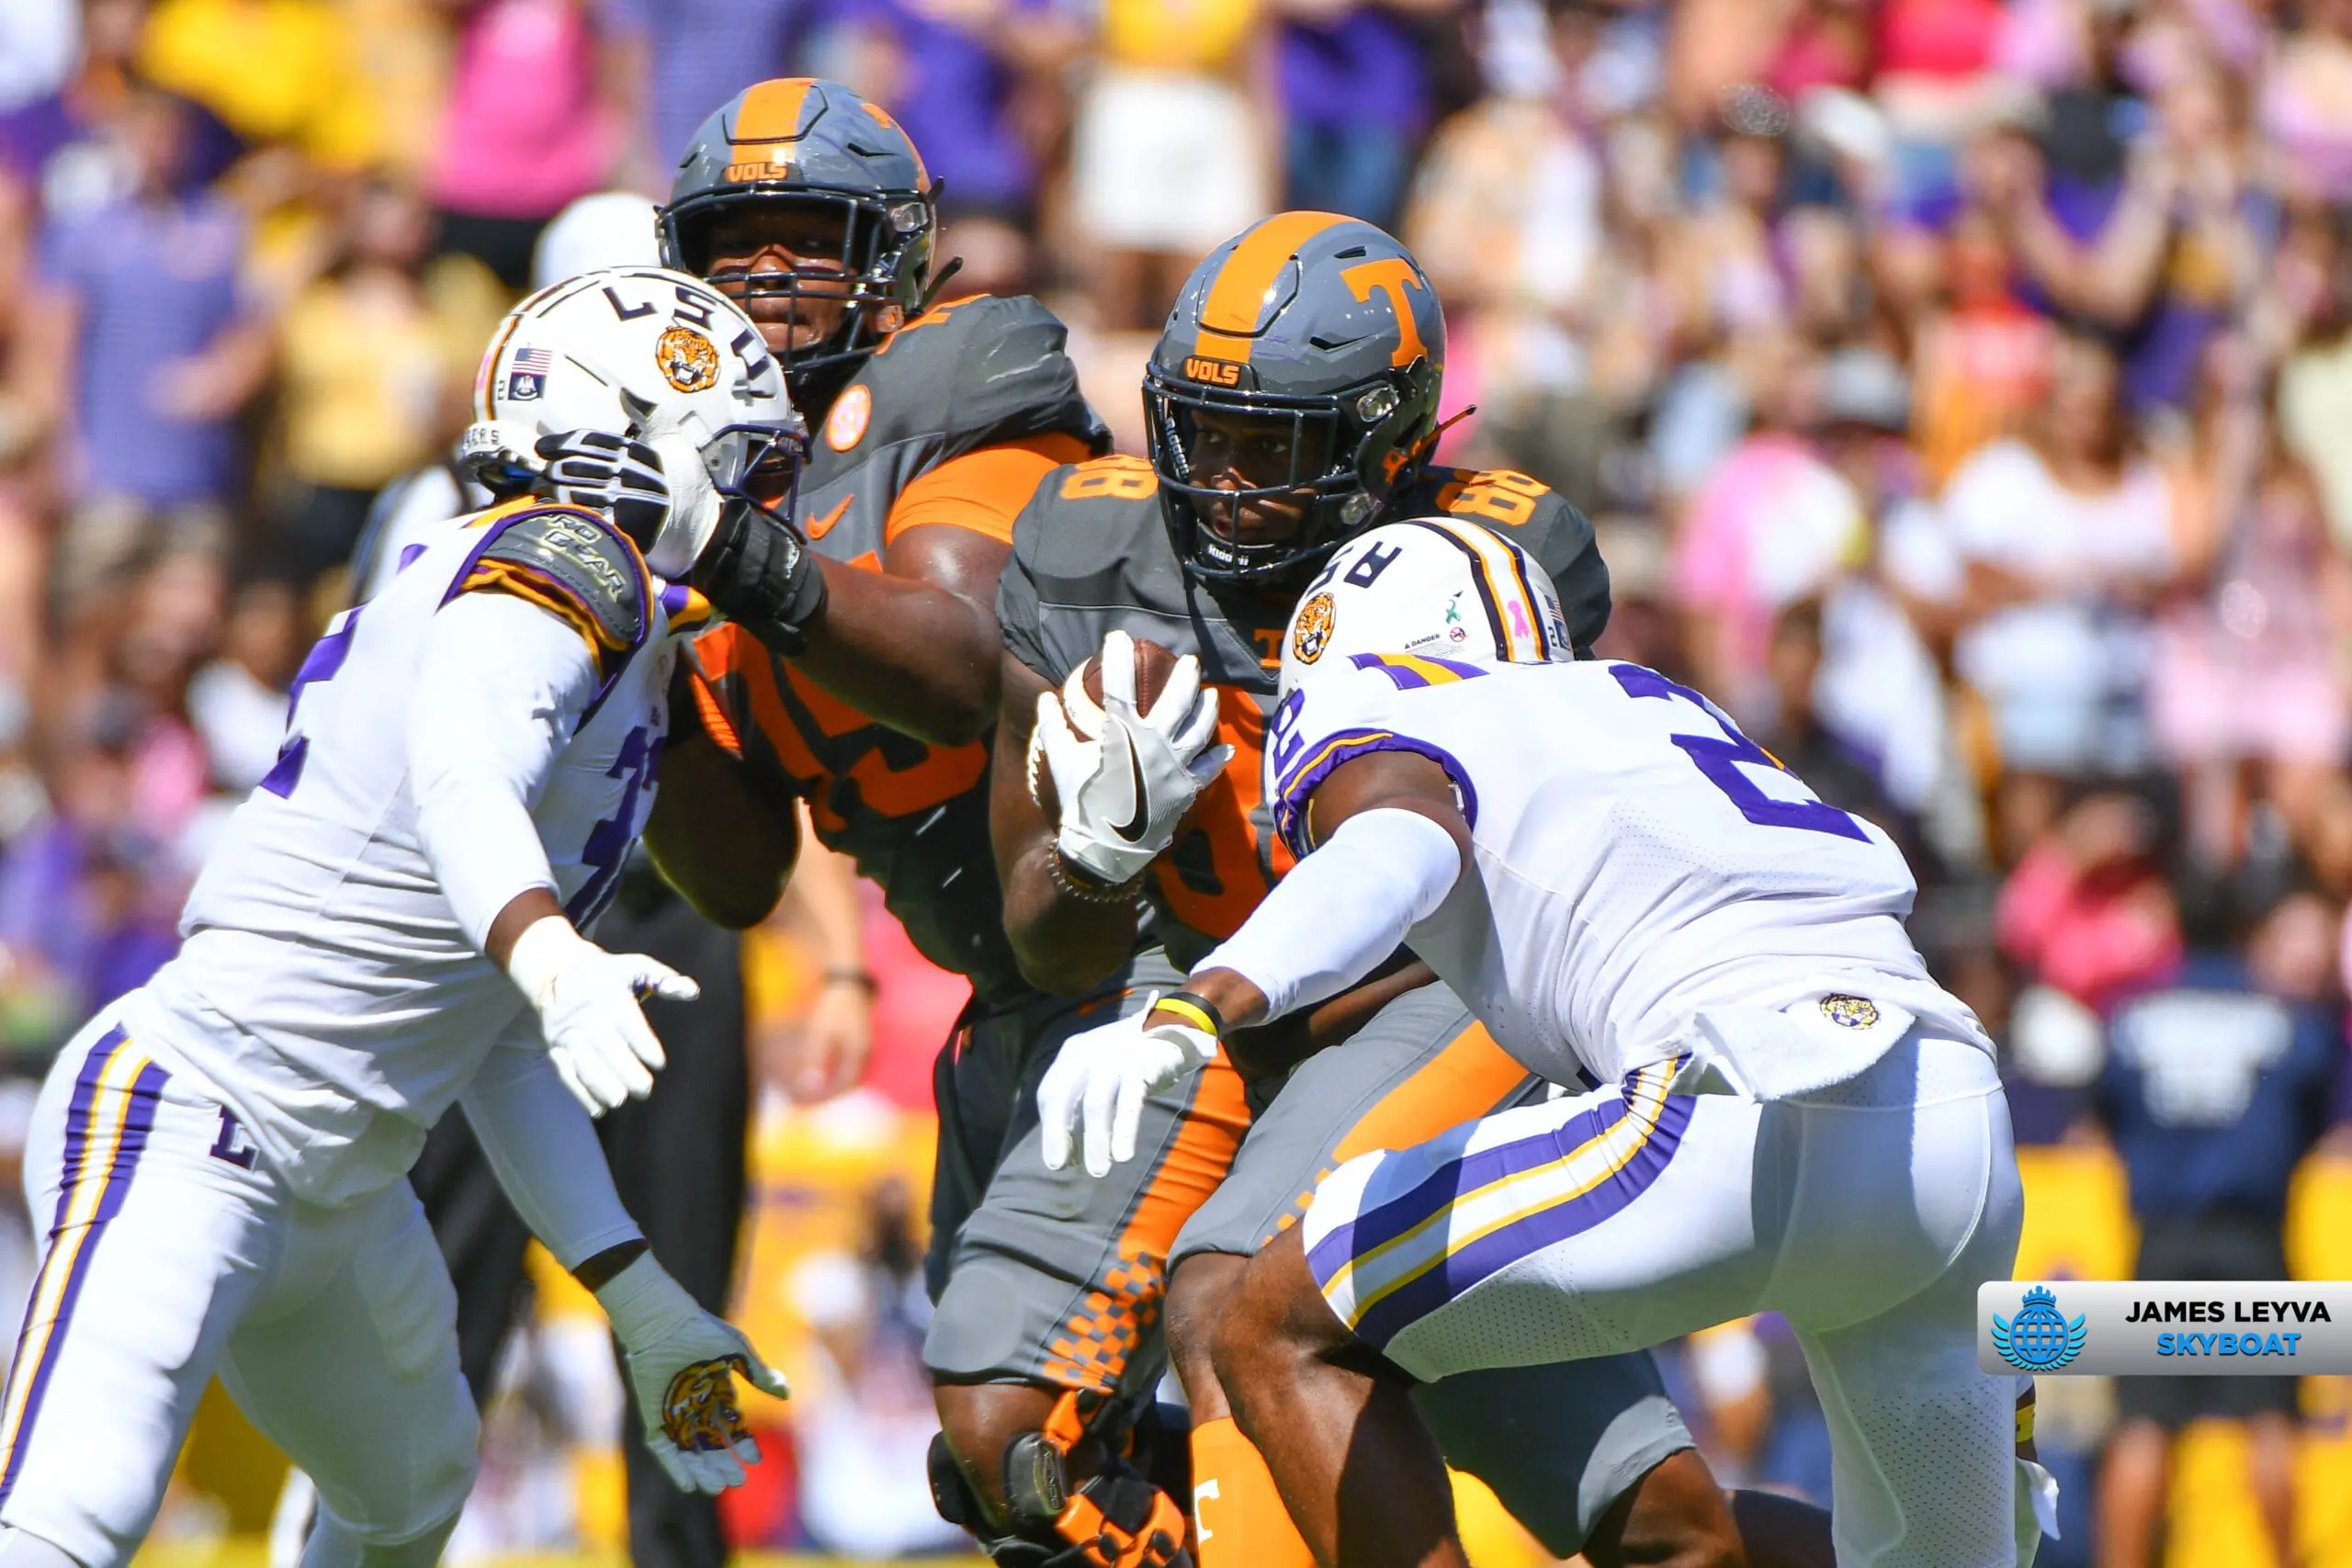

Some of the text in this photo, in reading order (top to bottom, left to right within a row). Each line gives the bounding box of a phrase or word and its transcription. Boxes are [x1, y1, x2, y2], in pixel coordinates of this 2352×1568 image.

[727, 162, 787, 183] VOLS
[1340, 258, 1428, 367] T
[1186, 358, 1239, 385] VOLS
[1411, 633, 1441, 648] DANGER
[1608, 663, 1875, 844] 2
[209, 1104, 258, 1170] L
